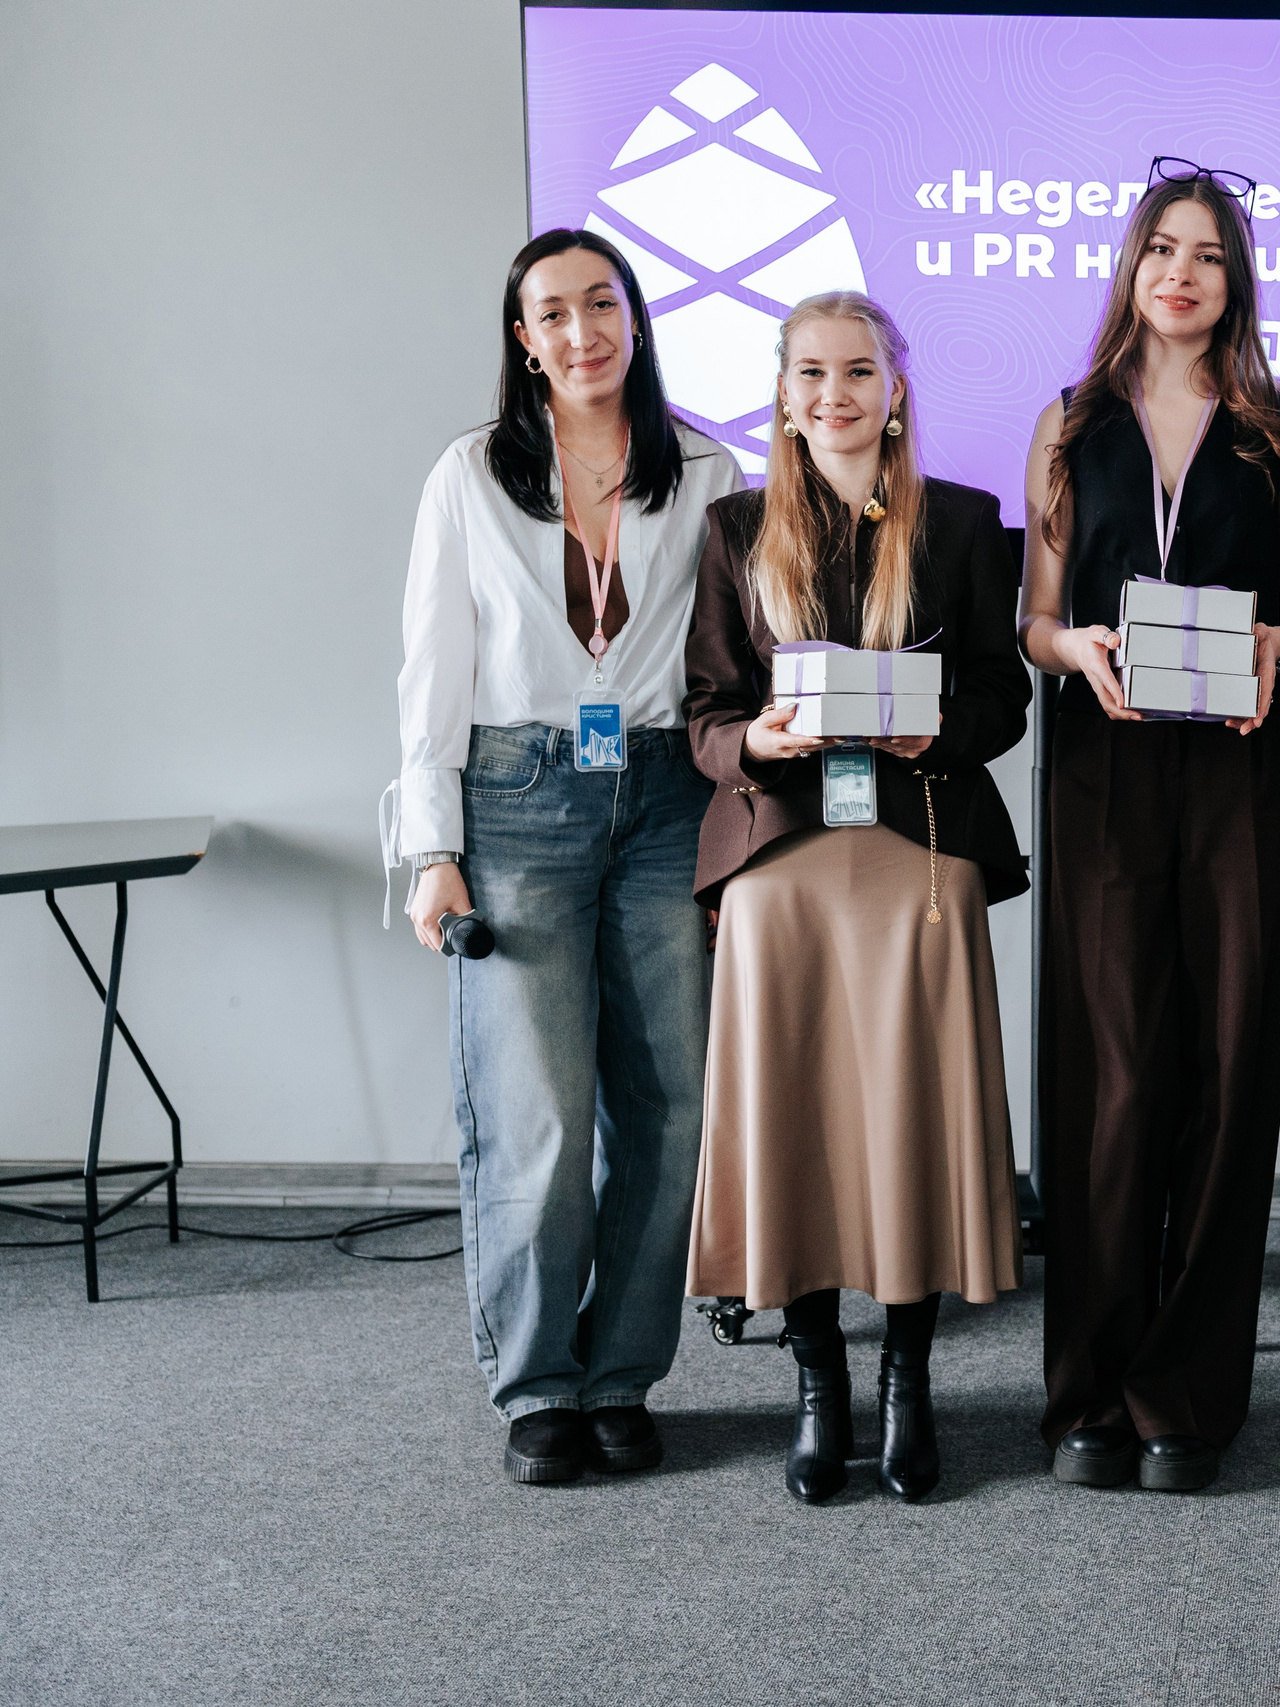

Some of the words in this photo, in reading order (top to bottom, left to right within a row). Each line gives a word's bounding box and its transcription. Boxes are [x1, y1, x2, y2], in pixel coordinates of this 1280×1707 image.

[914, 168, 1150, 222] «Недел
[915, 240, 947, 277] и
[973, 233, 1056, 278] PR
[1075, 242, 1123, 280] н
